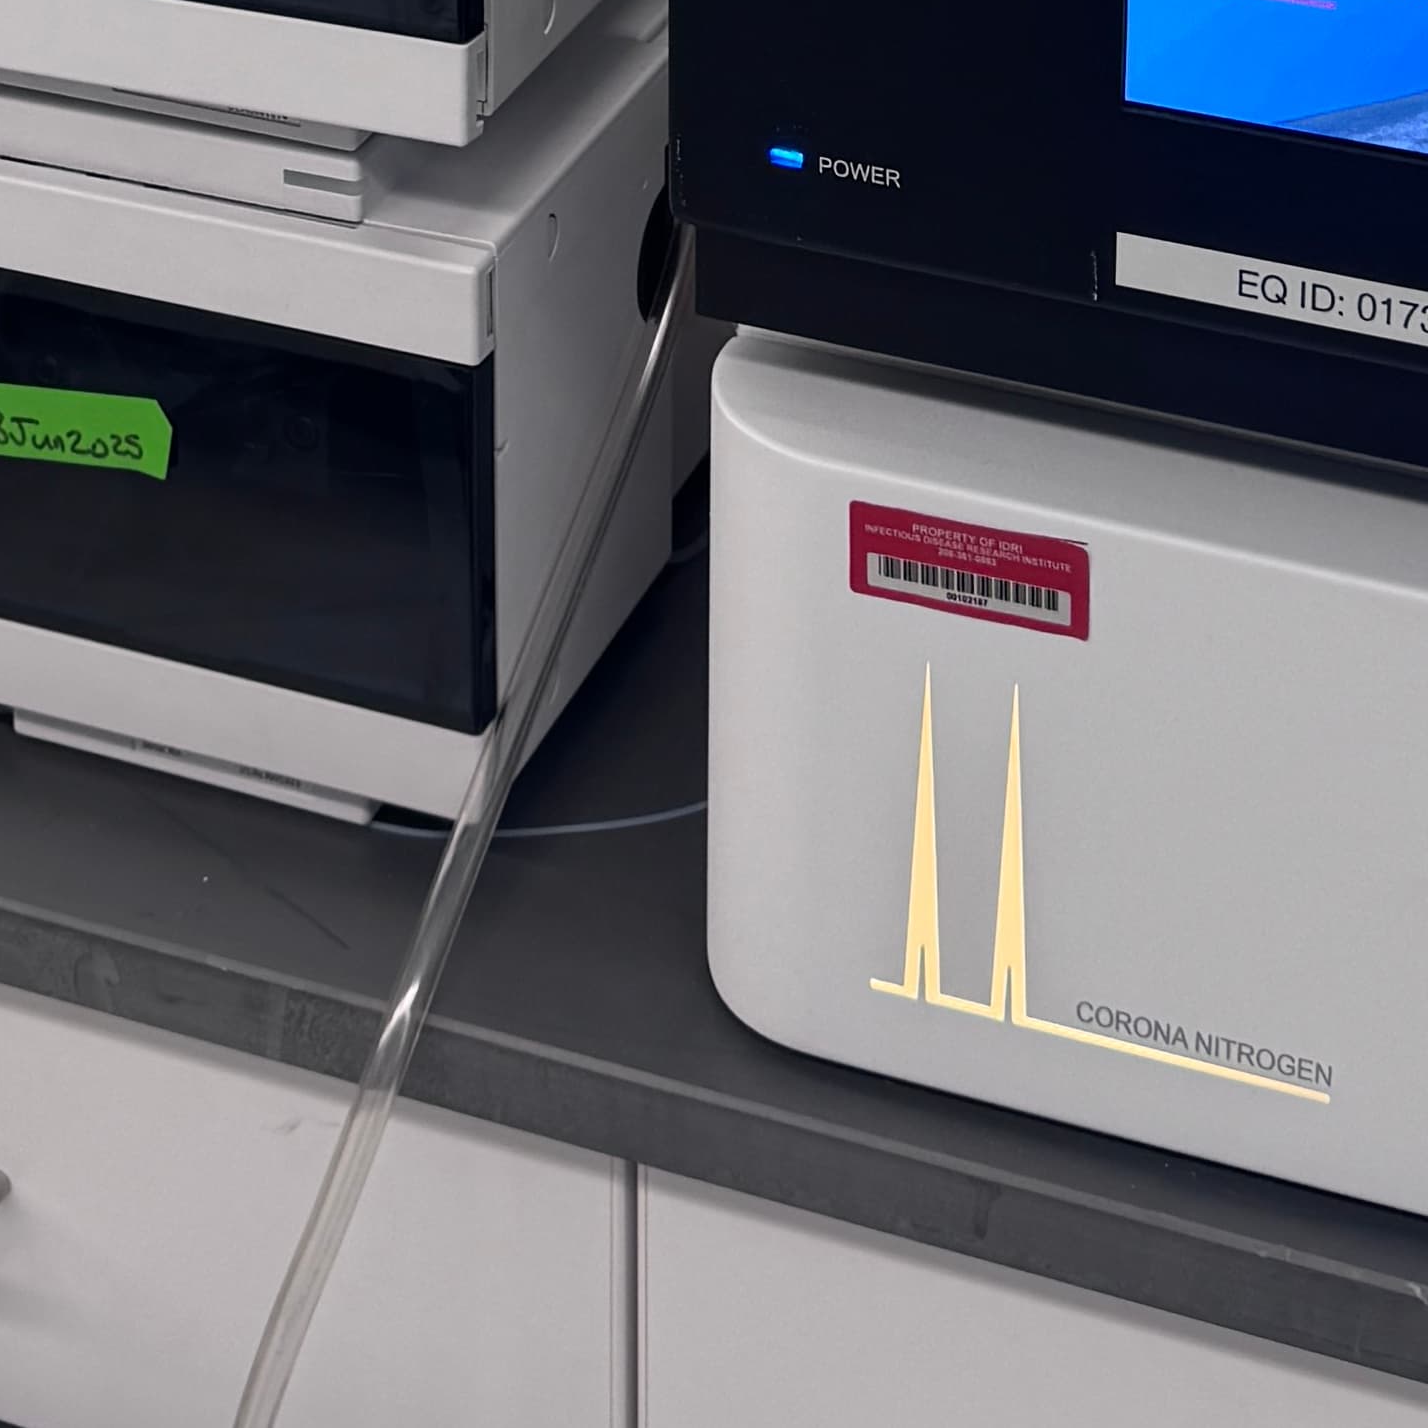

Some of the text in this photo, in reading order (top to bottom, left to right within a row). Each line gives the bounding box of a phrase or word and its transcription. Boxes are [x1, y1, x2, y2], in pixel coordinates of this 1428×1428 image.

[818, 156, 902, 189] POWER
[1237, 268, 1288, 306] EQ
[1300, 280, 1345, 317] ID:
[864, 523, 1073, 573] INFECTIOUS DISEASE RESEARCH INSTITUTE
[912, 523, 1024, 554] PROPERTY OF IDRI
[1075, 1000, 1334, 1088] CORONA NITROGEN
